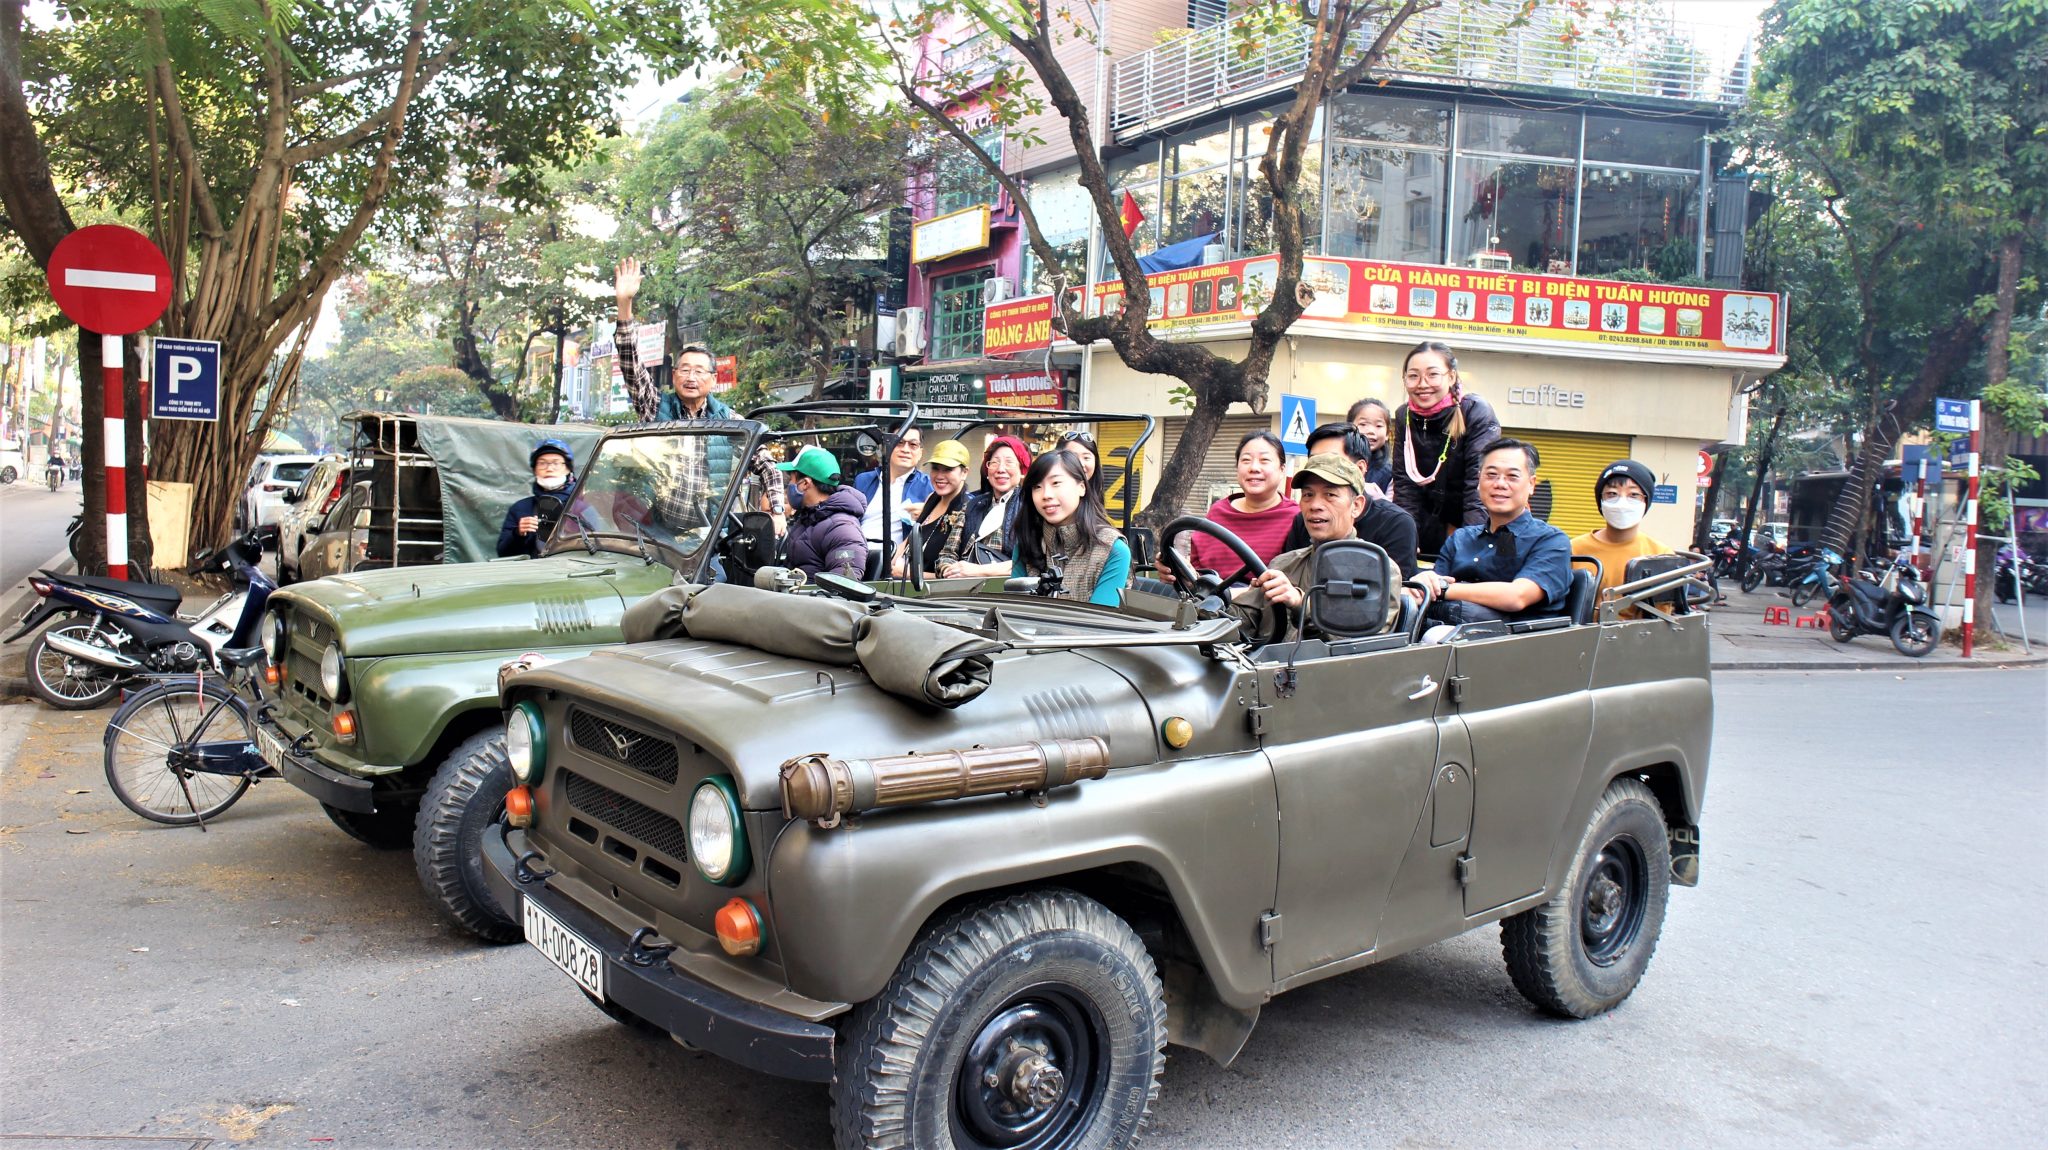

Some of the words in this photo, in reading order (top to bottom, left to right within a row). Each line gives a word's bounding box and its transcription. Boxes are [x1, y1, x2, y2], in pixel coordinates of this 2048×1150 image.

[1158, 273, 1176, 286] ĐIỆN
[1178, 269, 1198, 281] TUẤN
[1201, 265, 1229, 278] HƯƠNG
[1364, 264, 1402, 284] CỬA
[1408, 269, 1460, 288] HÀNG
[1466, 274, 1517, 292] THIẾT
[1522, 280, 1541, 297] BỊ
[1546, 281, 1590, 299] ĐIỆN
[1595, 283, 1642, 302] TUẤN
[1648, 290, 1710, 307] HƯƠNG
[1107, 281, 1125, 292] HÀN
[985, 321, 1022, 348] HOÀNG
[1024, 319, 1051, 343] ANH
[169, 355, 202, 394] P
[929, 373, 959, 384] HONGKONG
[989, 375, 1015, 393] TUẤN
[1016, 376, 1053, 391] HƯƠNG
[1001, 393, 1031, 406] PHÙNG
[1031, 393, 1058, 405] HƯNG
[1508, 384, 1584, 408] coffee
